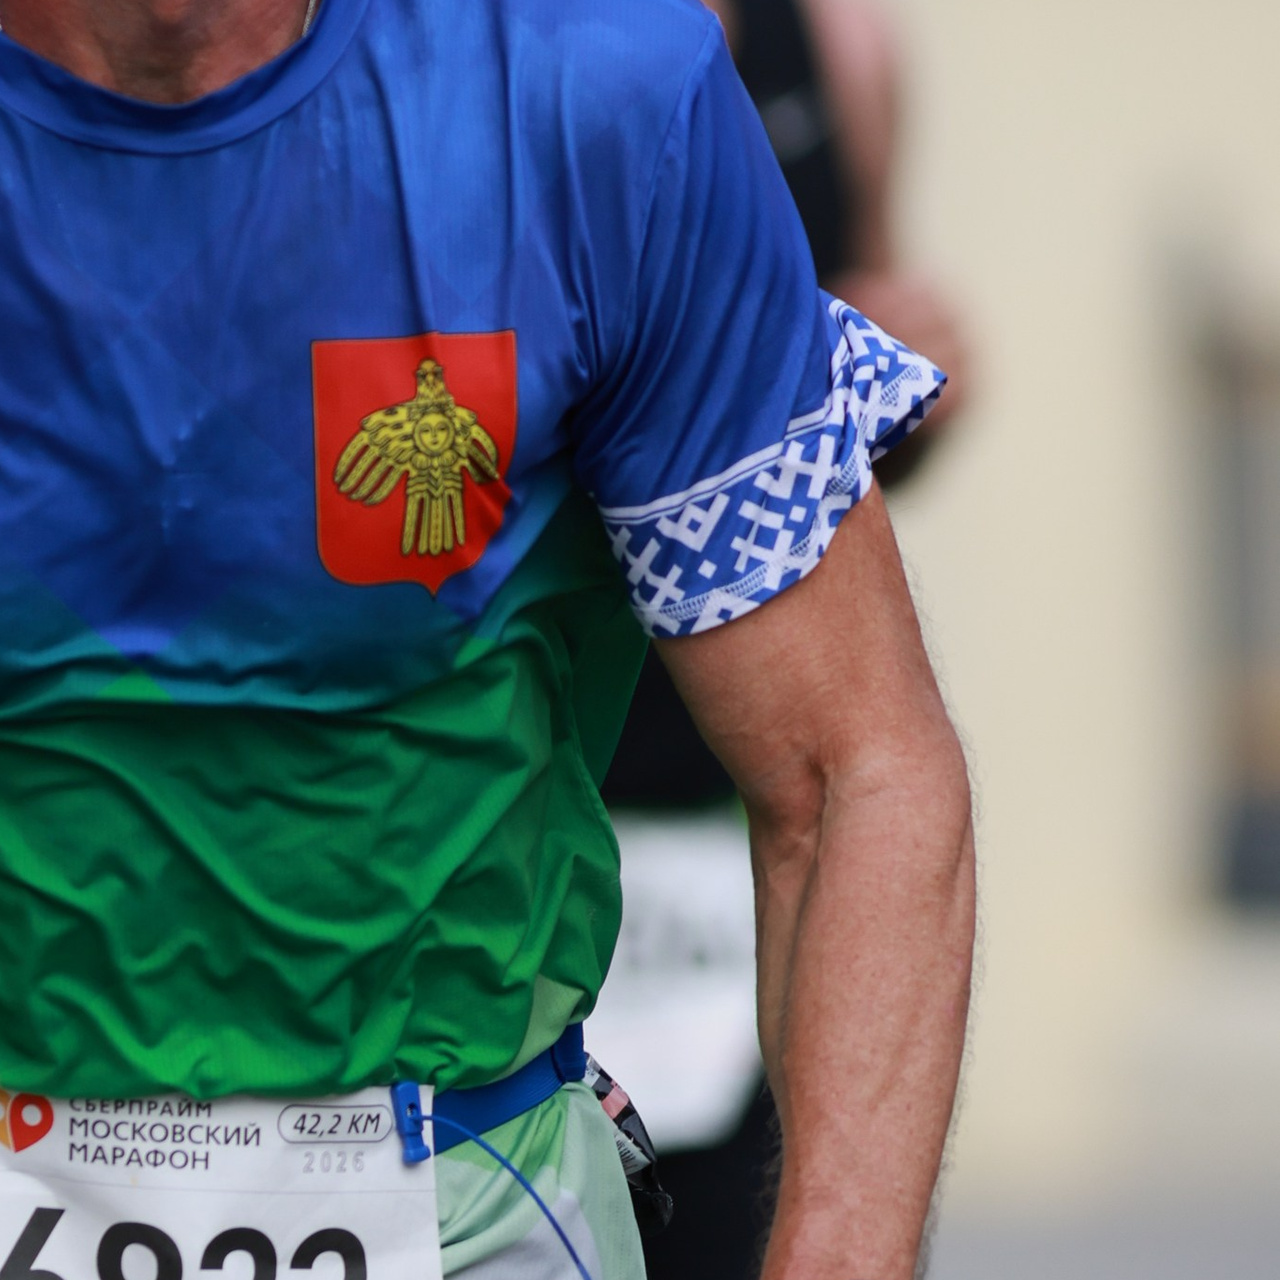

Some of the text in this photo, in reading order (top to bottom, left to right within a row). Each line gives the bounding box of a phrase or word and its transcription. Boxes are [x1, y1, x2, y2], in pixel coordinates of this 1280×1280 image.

[69, 1117, 261, 1147] МОСКОВСКИЙ
[292, 1113, 342, 1136] 42,2
[69, 1143, 210, 1170] МАРАФОН
[303, 1150, 365, 1173] 2026
